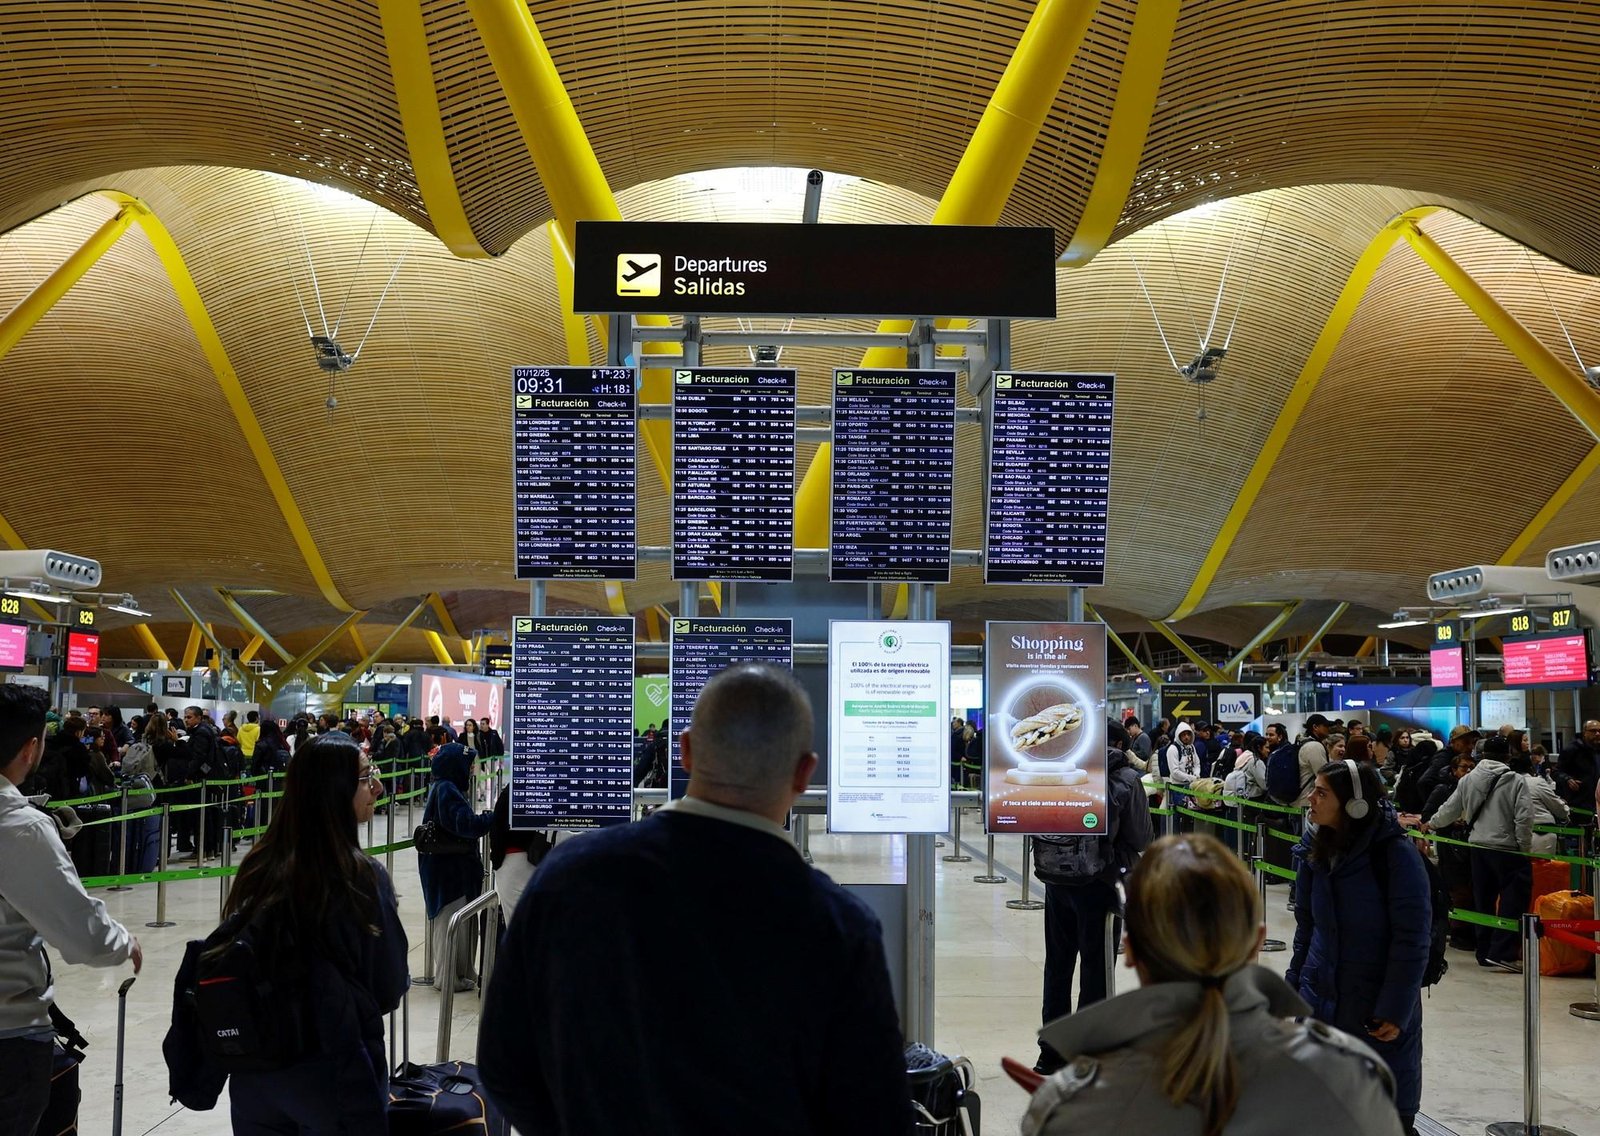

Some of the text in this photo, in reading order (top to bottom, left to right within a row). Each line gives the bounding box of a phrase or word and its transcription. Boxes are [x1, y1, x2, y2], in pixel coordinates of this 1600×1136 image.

[674, 255, 768, 276] Departures
[673, 276, 746, 296] Salidas
[517, 369, 550, 377] 01/12/25
[695, 374, 749, 383] Facturación
[517, 377, 563, 393] 09:31
[856, 376, 947, 386] Facturación Check-in
[1015, 379, 1068, 388] Facturación
[535, 398, 589, 408] Facturación
[1, 598, 19, 615] 828
[80, 610, 93, 625] 829
[1512, 615, 1529, 632] 818
[1552, 609, 1570, 627] 817
[535, 623, 588, 632] Facturación
[693, 624, 746, 633] Facturación
[1437, 625, 1452, 641] 819
[1011, 635, 1084, 654] Shopping
[217, 1028, 239, 1038] CATAI
